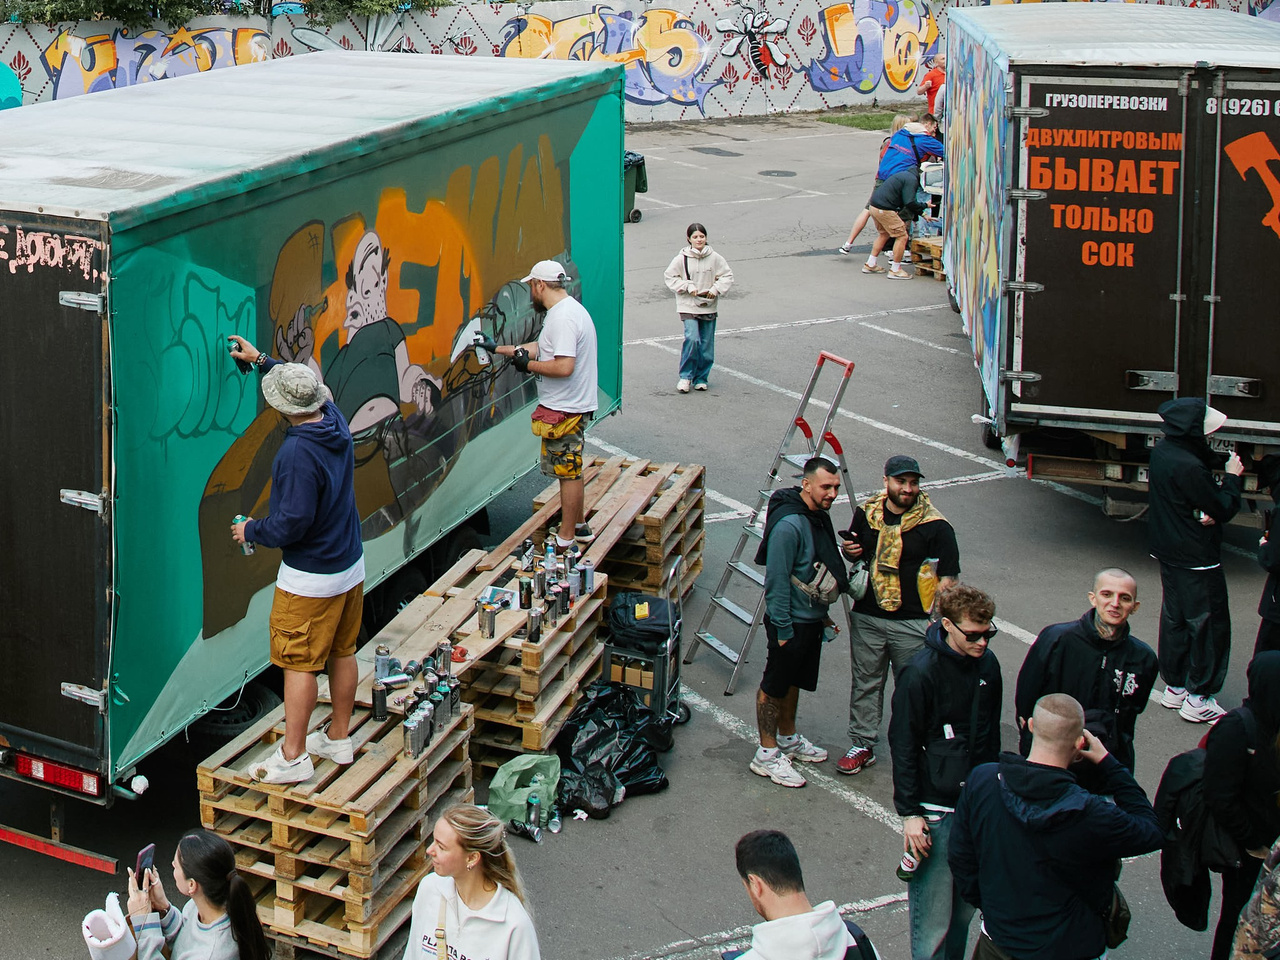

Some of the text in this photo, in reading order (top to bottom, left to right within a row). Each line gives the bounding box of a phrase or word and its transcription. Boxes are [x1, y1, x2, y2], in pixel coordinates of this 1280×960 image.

[1045, 93, 1168, 111] ГРУЗОПЕРЕВОЗКИ
[1205, 97, 1218, 115] 8
[1221, 98, 1271, 116] (926)
[1025, 128, 1183, 150] ДВУХЛИТРОВЫМ
[1030, 156, 1180, 195] БЫВАЕТ
[1050, 204, 1154, 234] ТОЛЬКО
[1081, 241, 1135, 267] СОК
